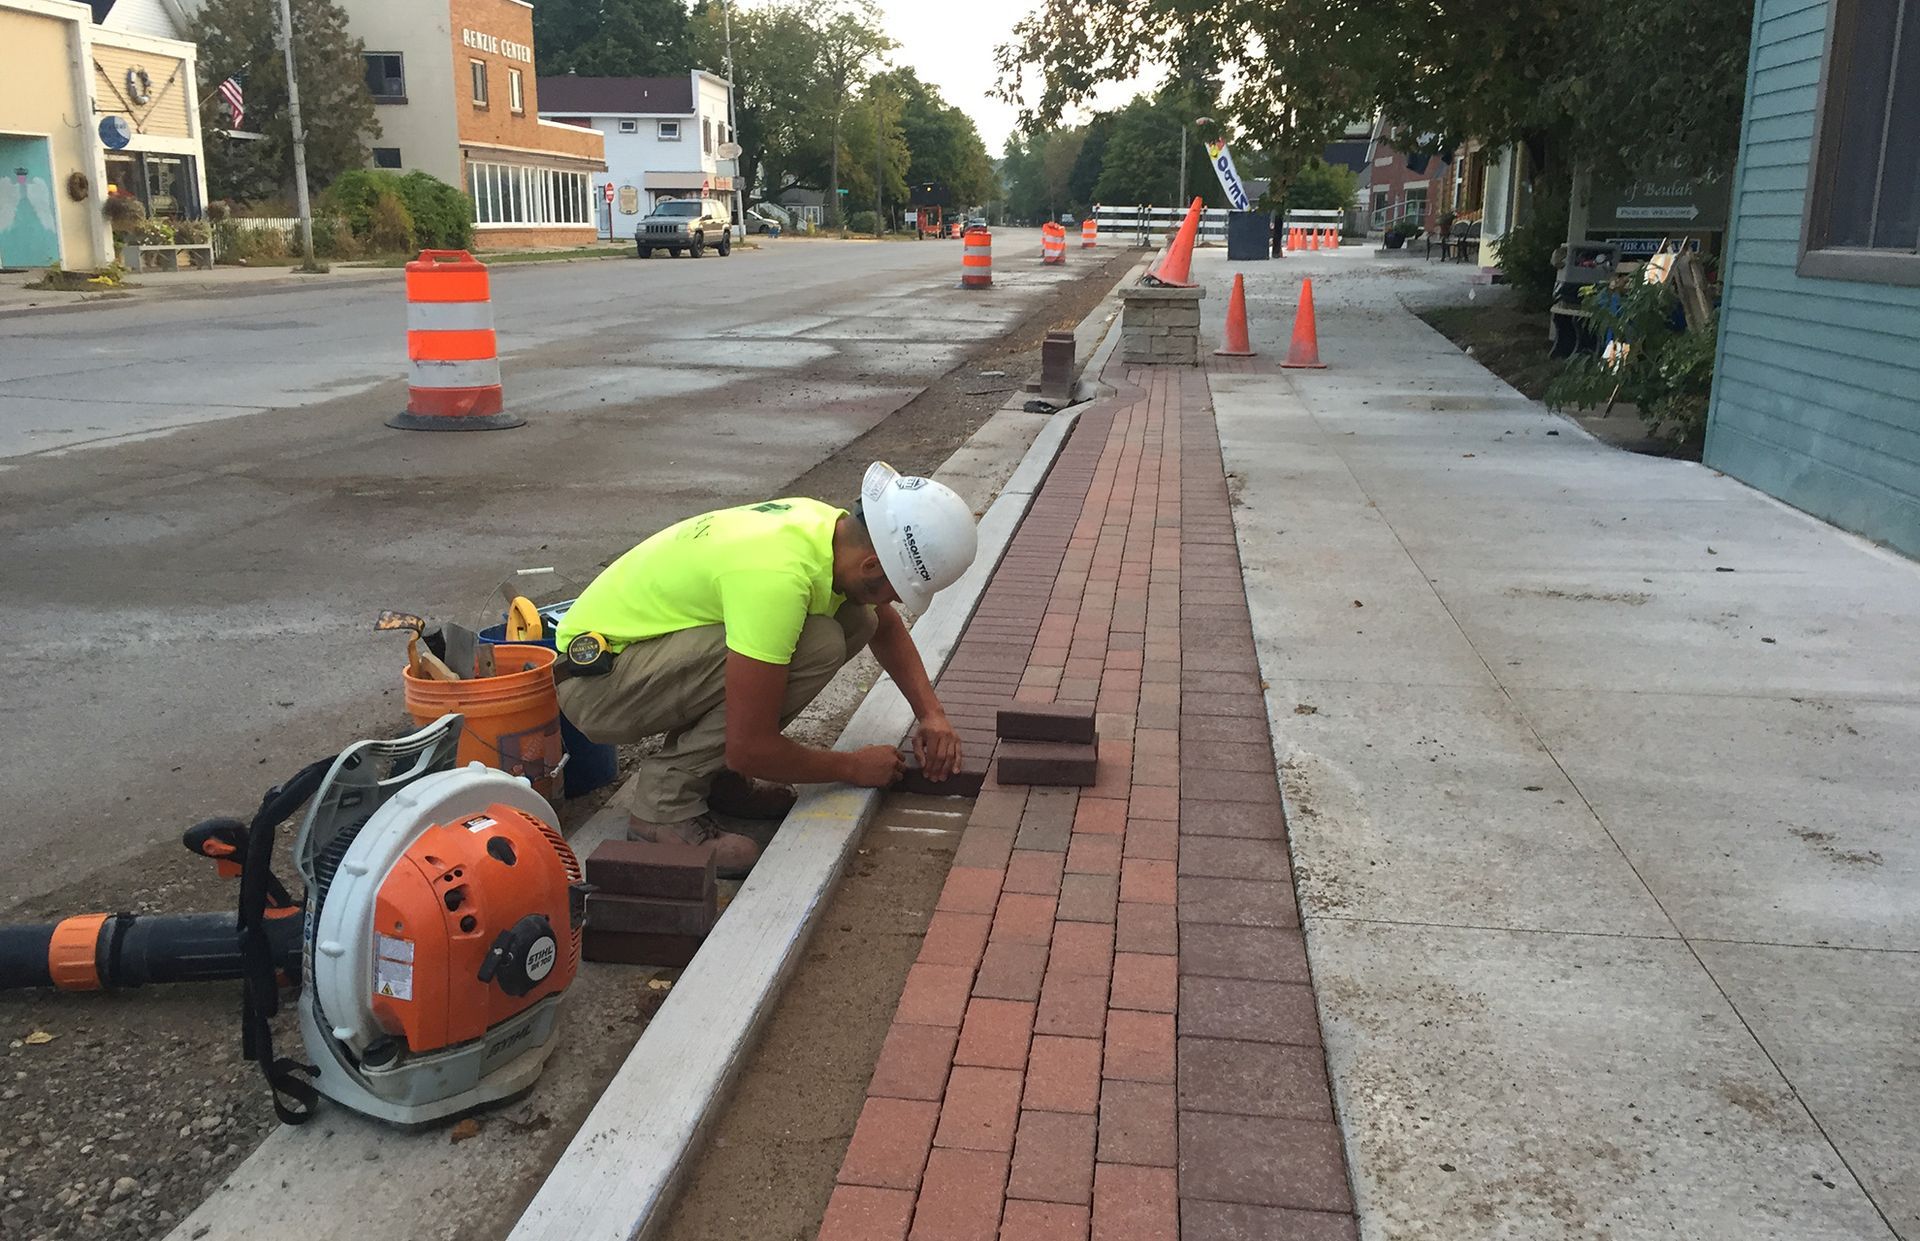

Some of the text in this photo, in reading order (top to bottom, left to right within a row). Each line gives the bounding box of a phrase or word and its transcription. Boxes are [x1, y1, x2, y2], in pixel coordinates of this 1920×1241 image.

[463, 28, 531, 64] BENZIE CENTER
[1624, 179, 1693, 202] of Beulah
[903, 525, 932, 582] SASQUATCH
[528, 946, 554, 966] STIHL
[486, 1024, 532, 1060] STIHL
